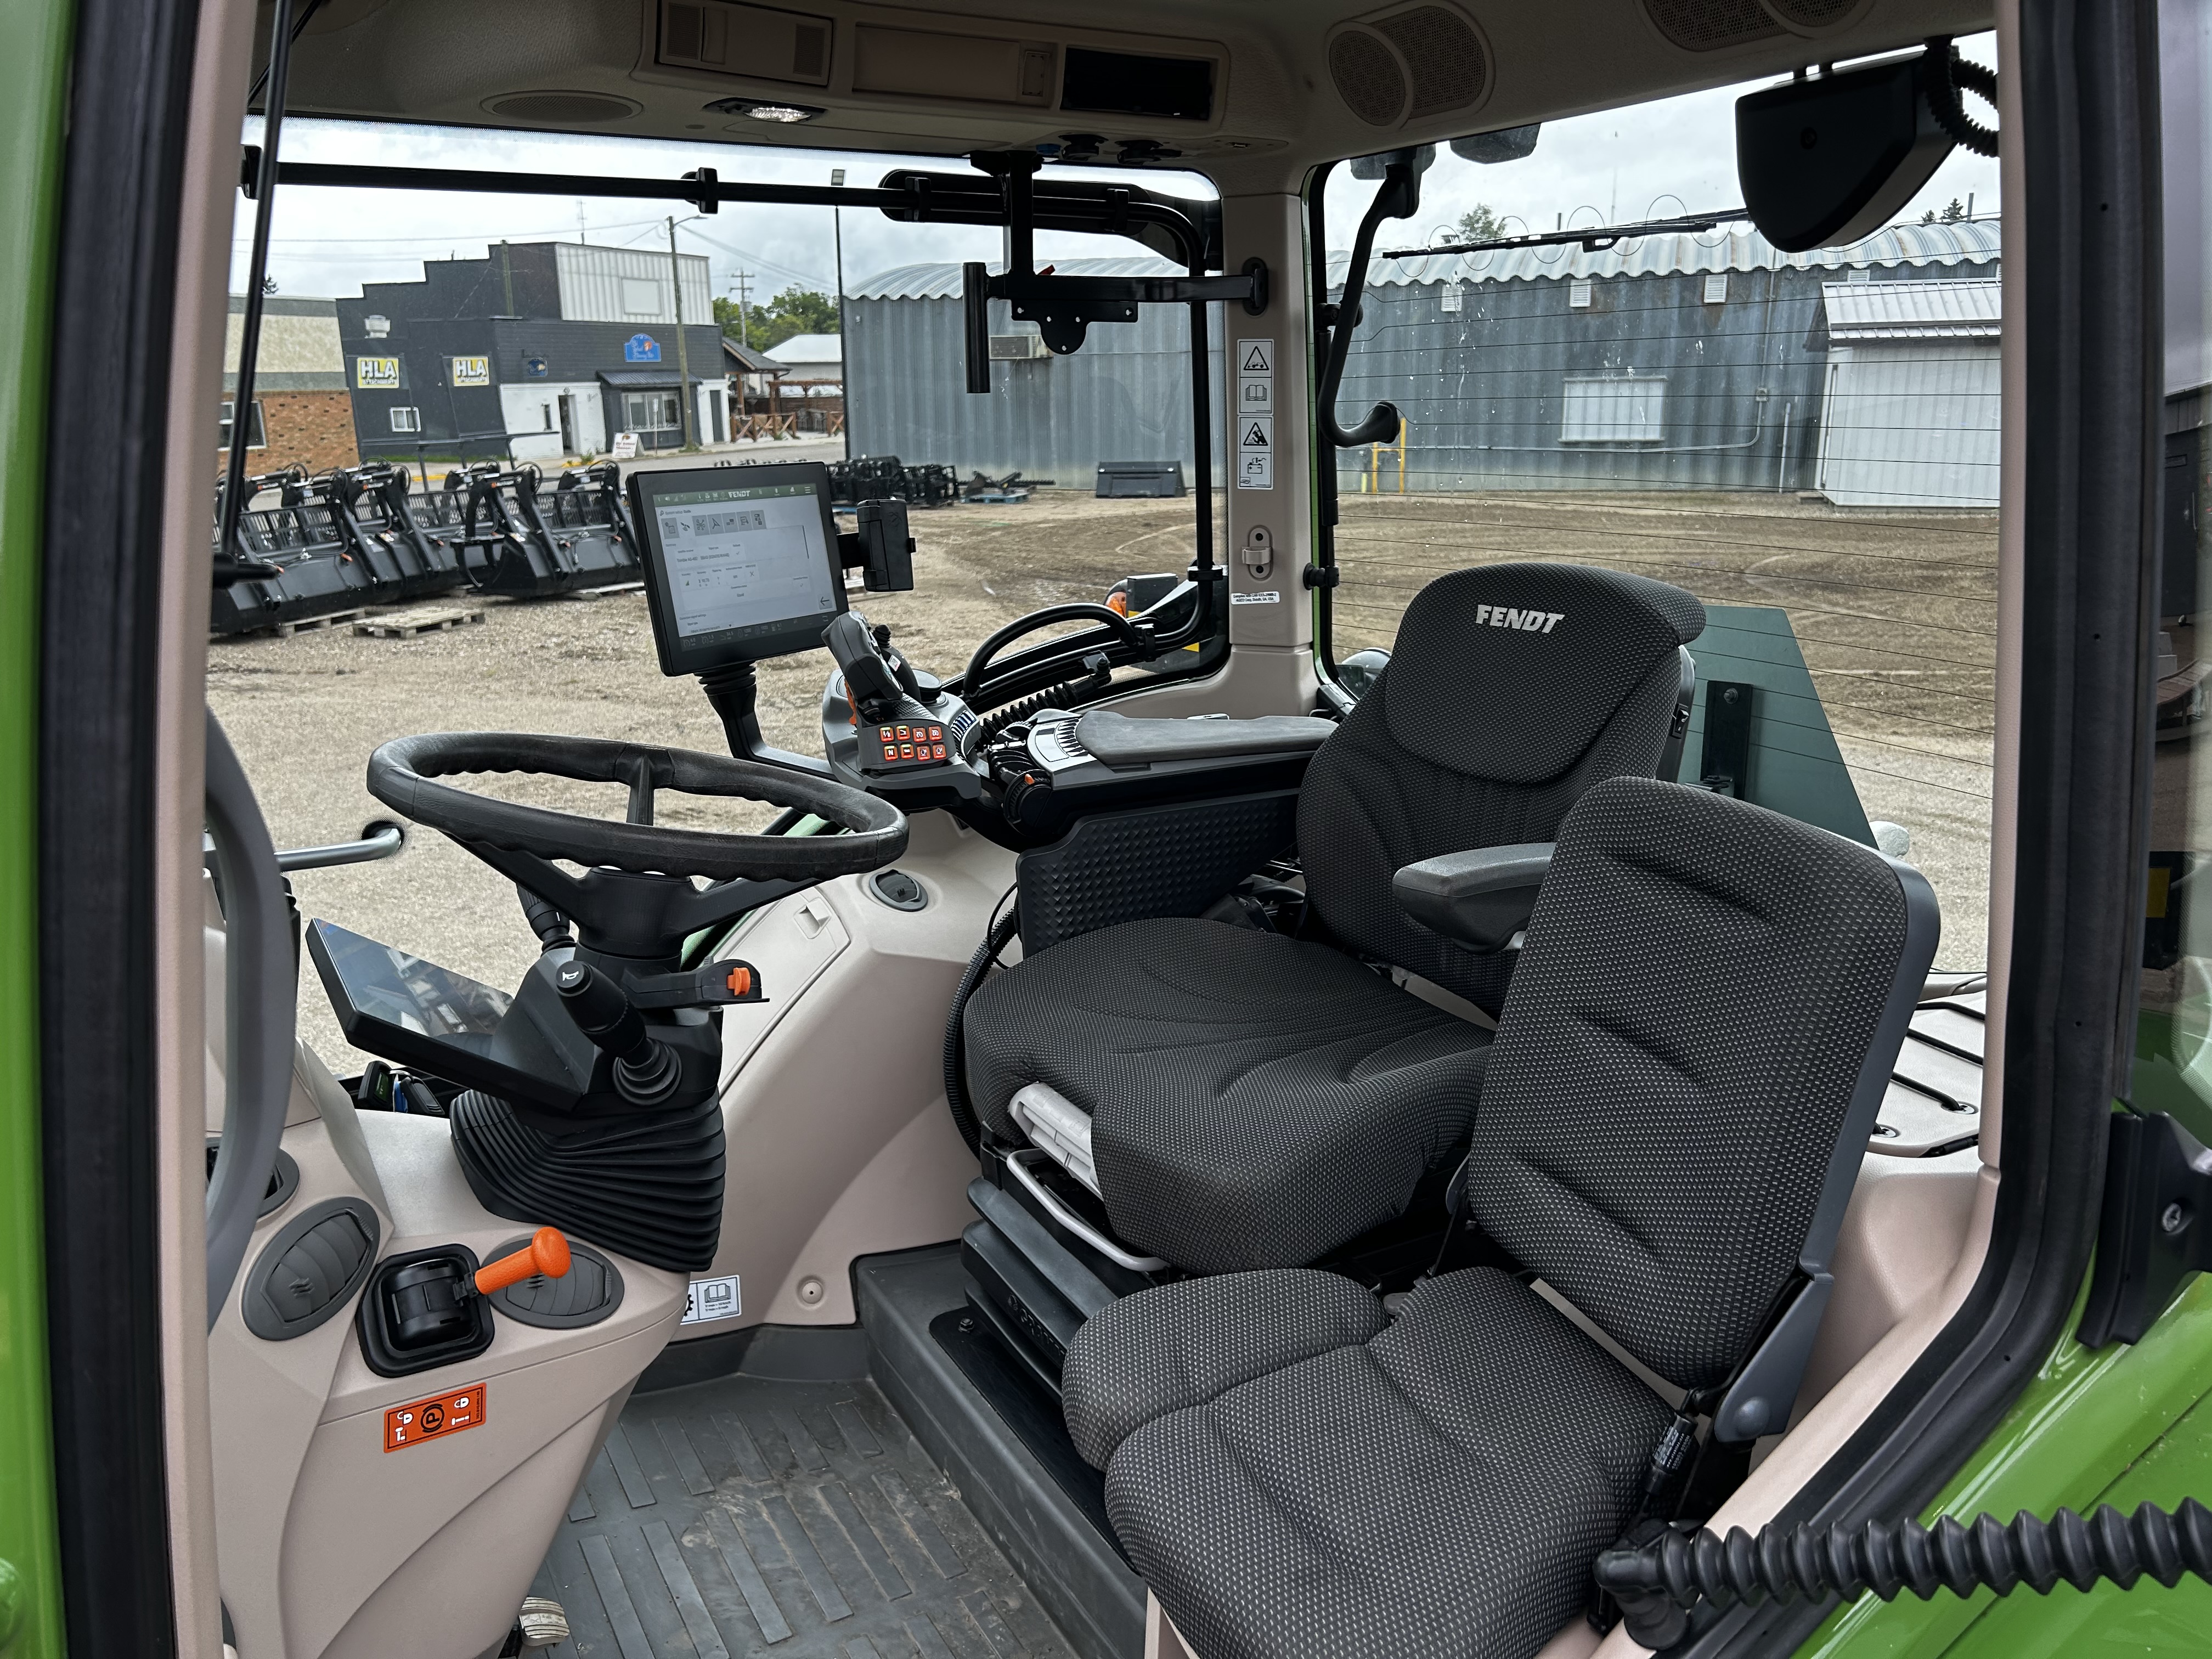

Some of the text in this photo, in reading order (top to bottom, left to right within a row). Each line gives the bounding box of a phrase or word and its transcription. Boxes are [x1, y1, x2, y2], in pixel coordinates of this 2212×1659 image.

[360, 360, 397, 379] HLA
[456, 359, 487, 377] HLA
[1475, 604, 1565, 634] FENDT
[426, 1412, 440, 1425] P
